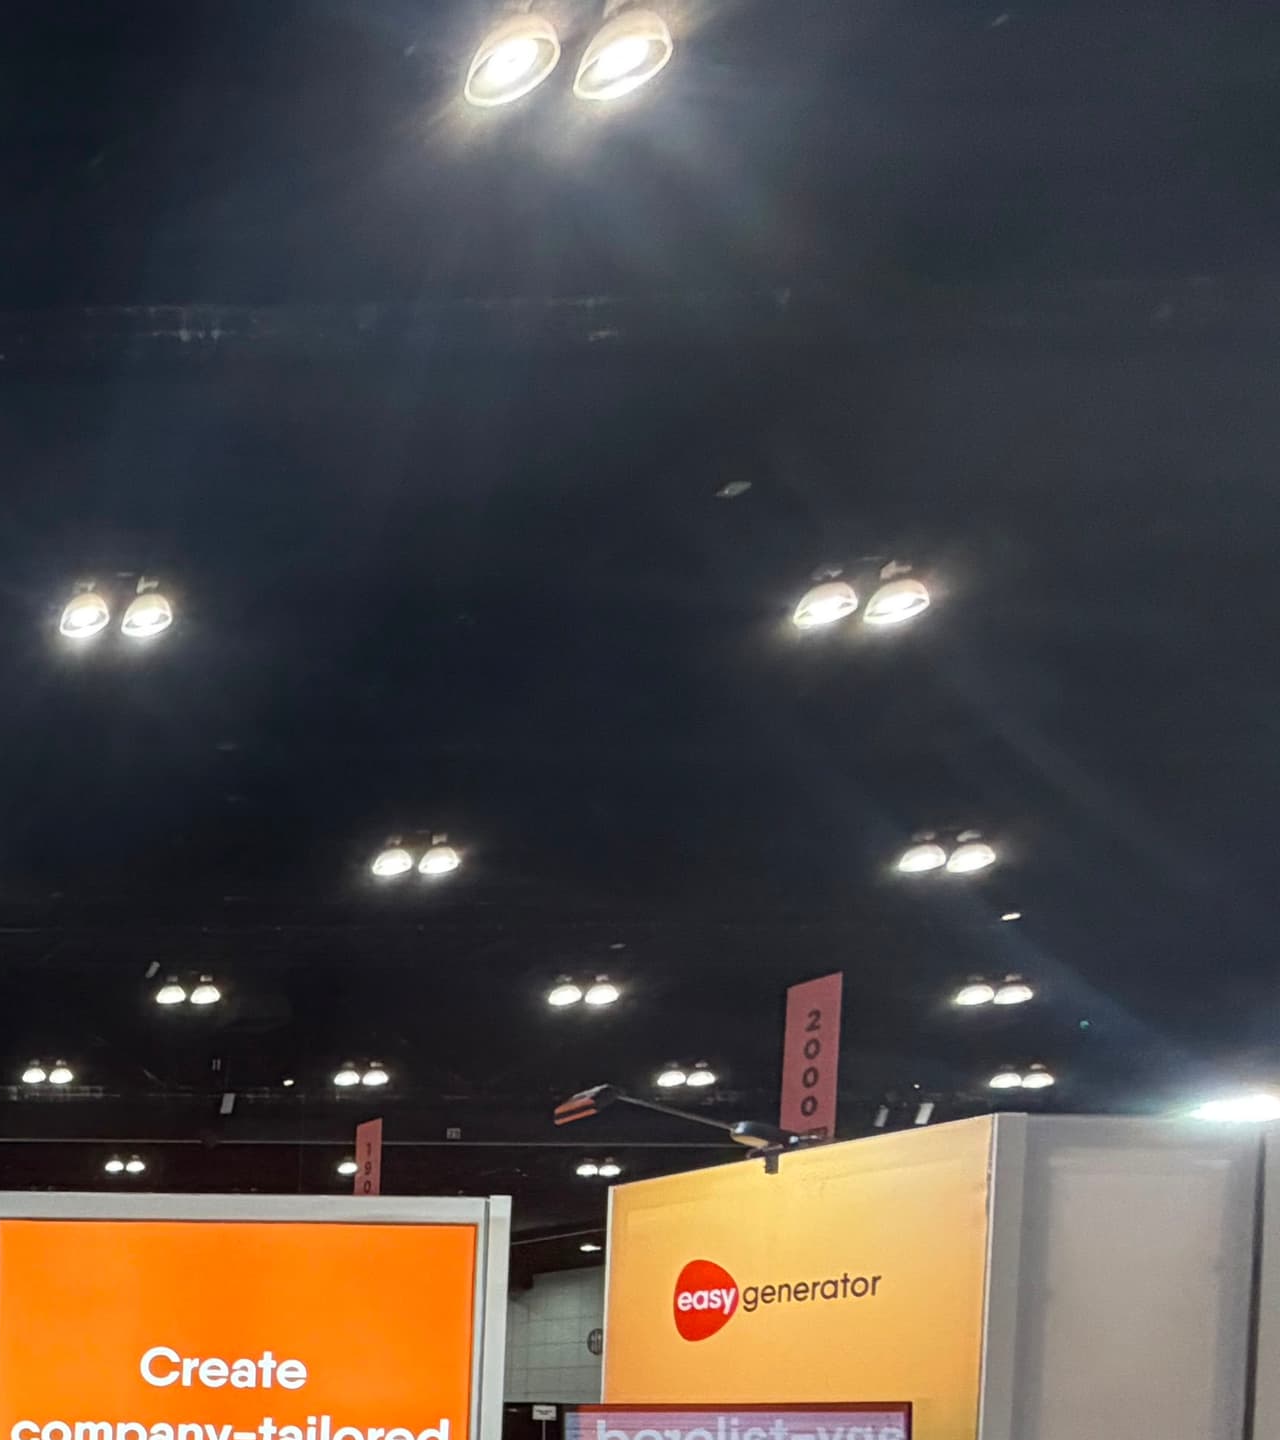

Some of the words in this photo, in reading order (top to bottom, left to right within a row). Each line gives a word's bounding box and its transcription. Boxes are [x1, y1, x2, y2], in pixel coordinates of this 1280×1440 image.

[800, 1008, 822, 1117] 2000
[677, 1287, 737, 1315] easy
[742, 1273, 882, 1313] generator
[140, 1345, 308, 1390] Create
